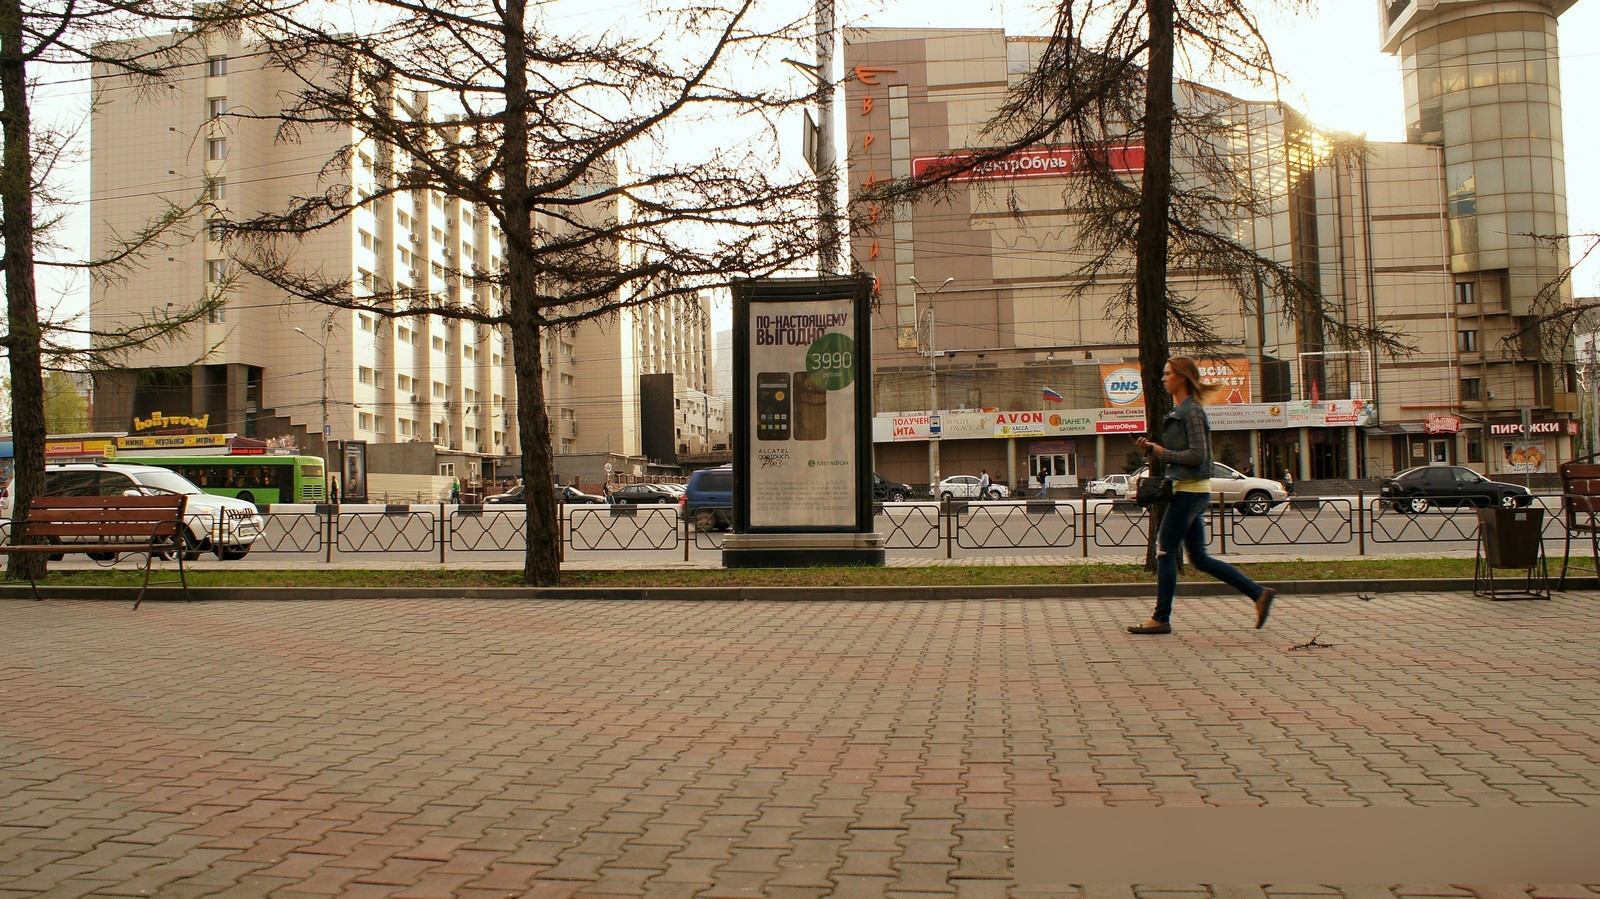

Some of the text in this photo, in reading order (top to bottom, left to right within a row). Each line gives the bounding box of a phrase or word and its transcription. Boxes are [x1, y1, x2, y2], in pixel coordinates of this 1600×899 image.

[756, 313, 848, 329] ПО-НАСТОЯЩЕМУ
[756, 328, 825, 346] ВЫГОДНО
[811, 351, 852, 370] 3990
[1198, 364, 1227, 377] ВОЙ
[1110, 381, 1139, 392] DNS
[1203, 376, 1245, 387] АРКЕТ
[134, 411, 210, 431] hollywood
[996, 412, 1043, 425] AVON
[1102, 423, 1138, 431] ЦентрОбувь
[1490, 422, 1560, 434] ПИРОЖКИ
